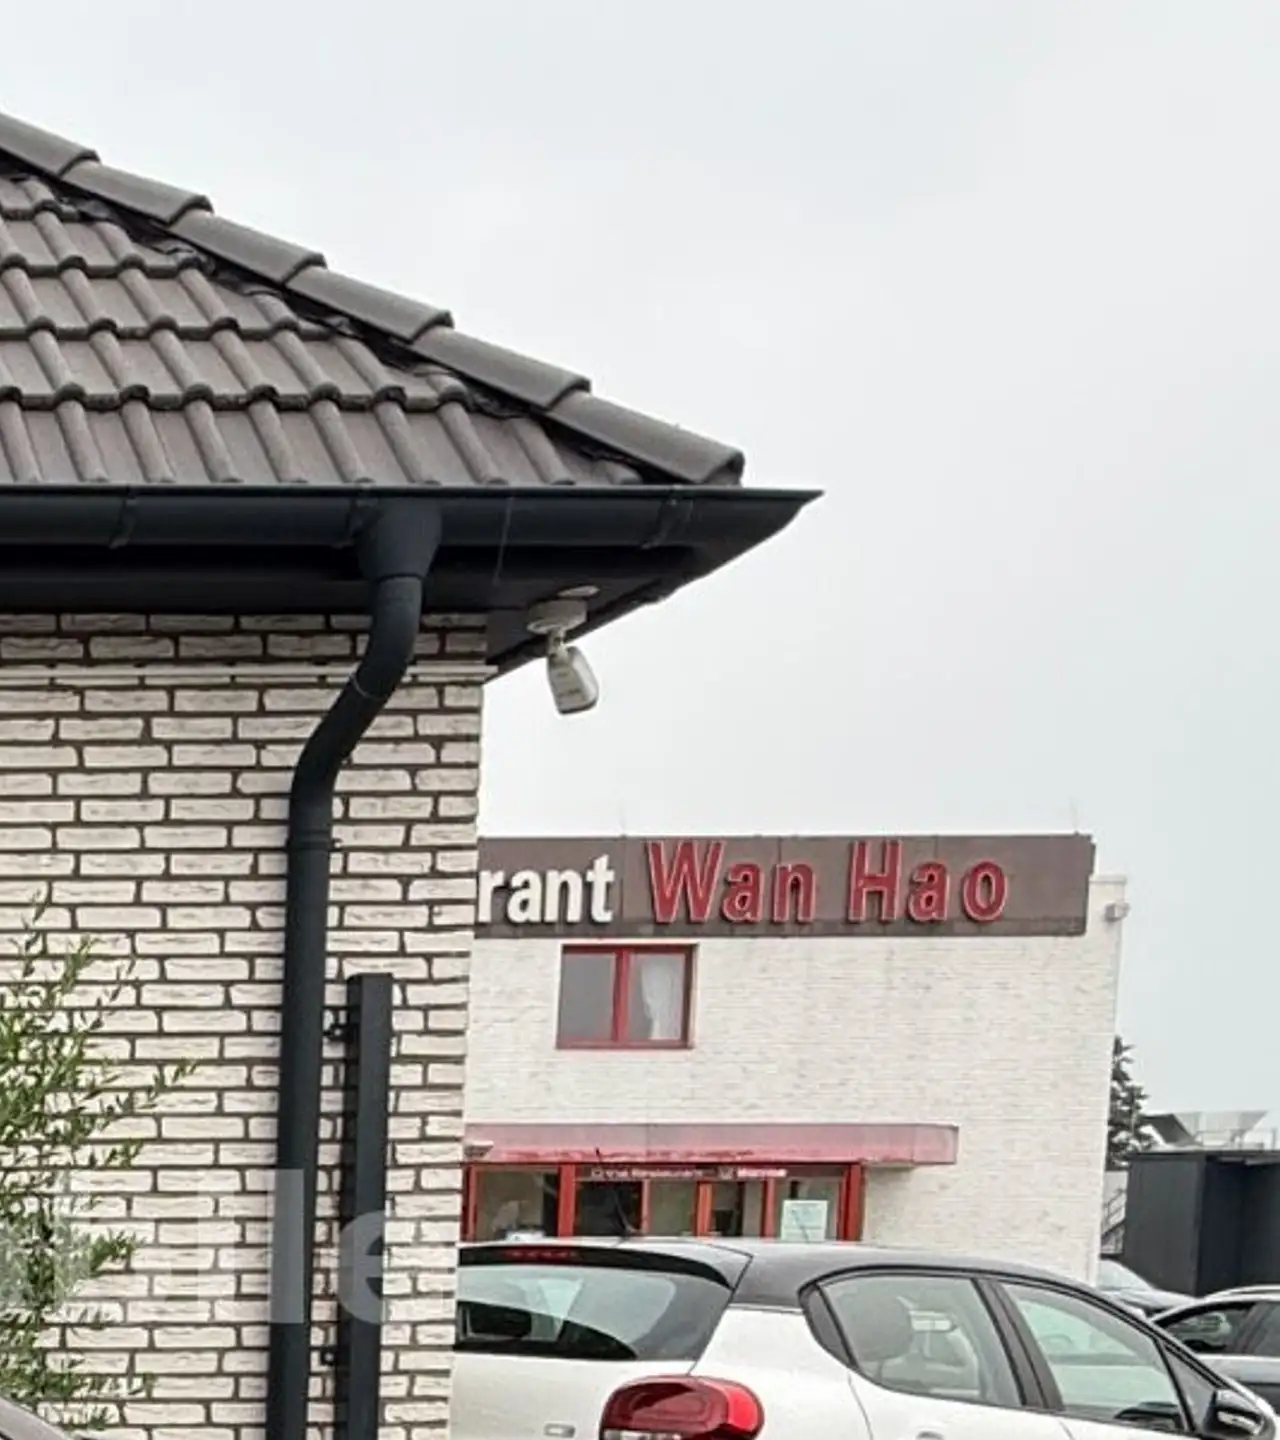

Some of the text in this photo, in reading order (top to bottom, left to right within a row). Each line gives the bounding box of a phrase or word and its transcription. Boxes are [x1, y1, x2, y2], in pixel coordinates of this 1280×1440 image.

[477, 839, 1008, 923] rant Wan Hao
